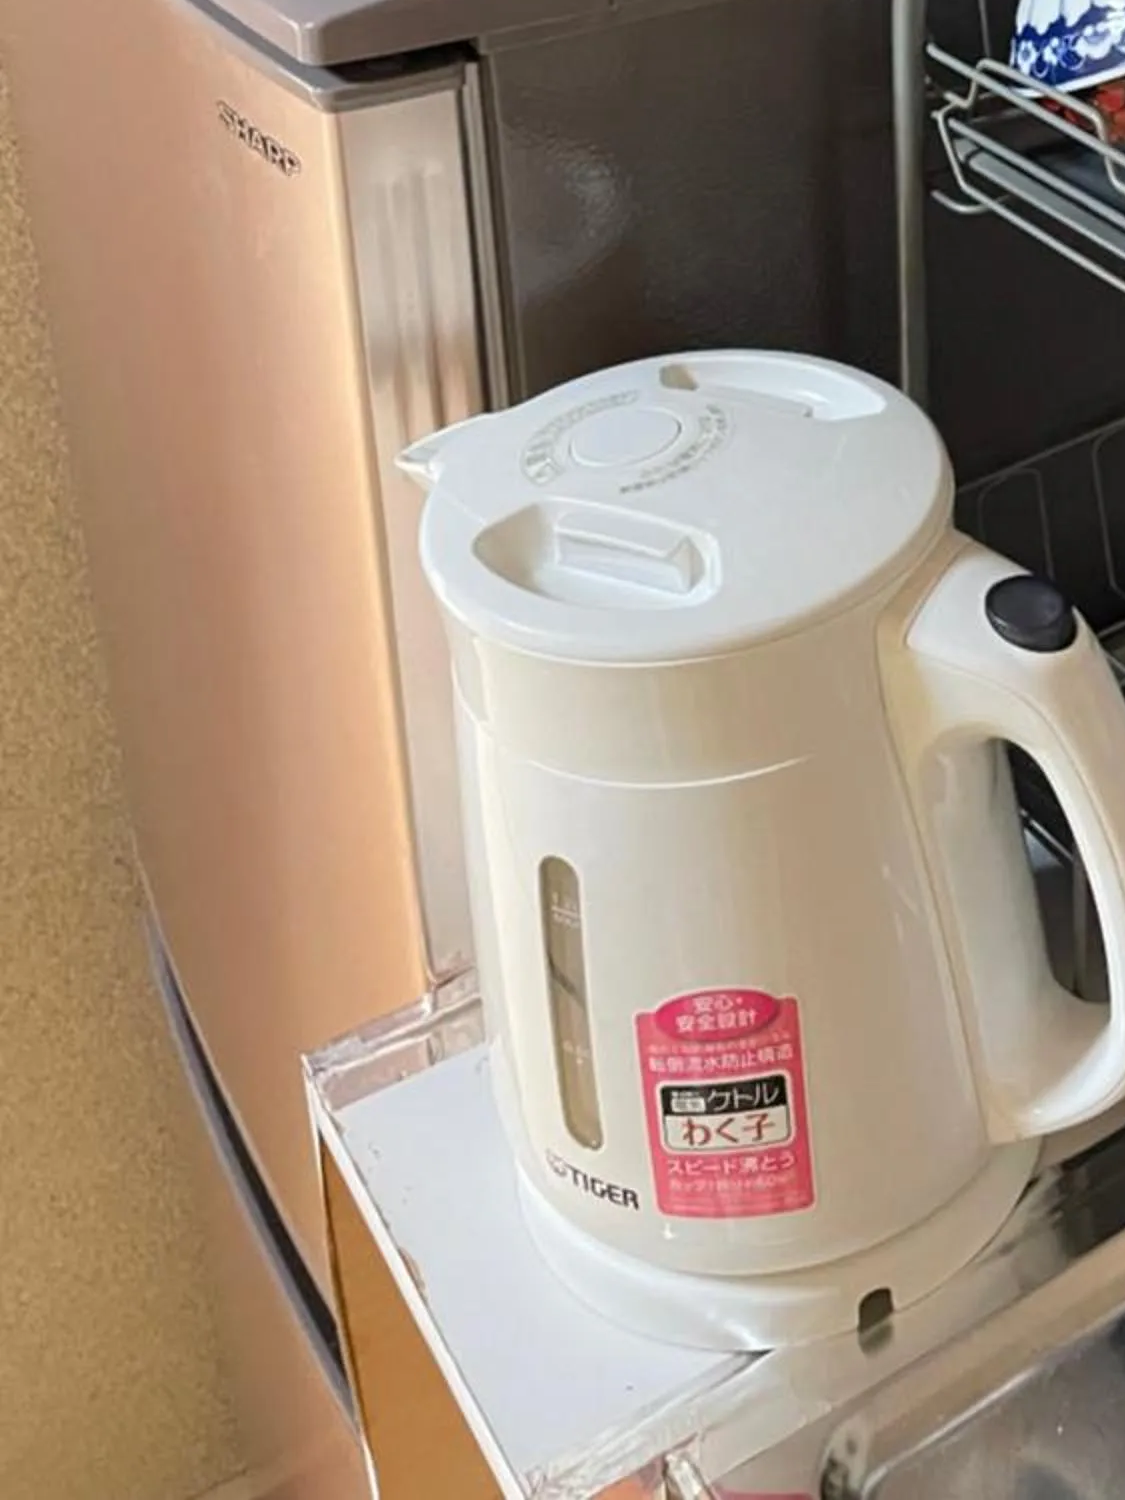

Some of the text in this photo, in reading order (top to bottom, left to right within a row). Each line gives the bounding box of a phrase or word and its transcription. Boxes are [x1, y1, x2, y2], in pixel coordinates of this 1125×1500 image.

[216, 100, 301, 176] SHARP
[675, 1008, 757, 1033] 安全設計
[681, 1112, 776, 1147] わく子
[563, 1161, 639, 1211] TIGER
